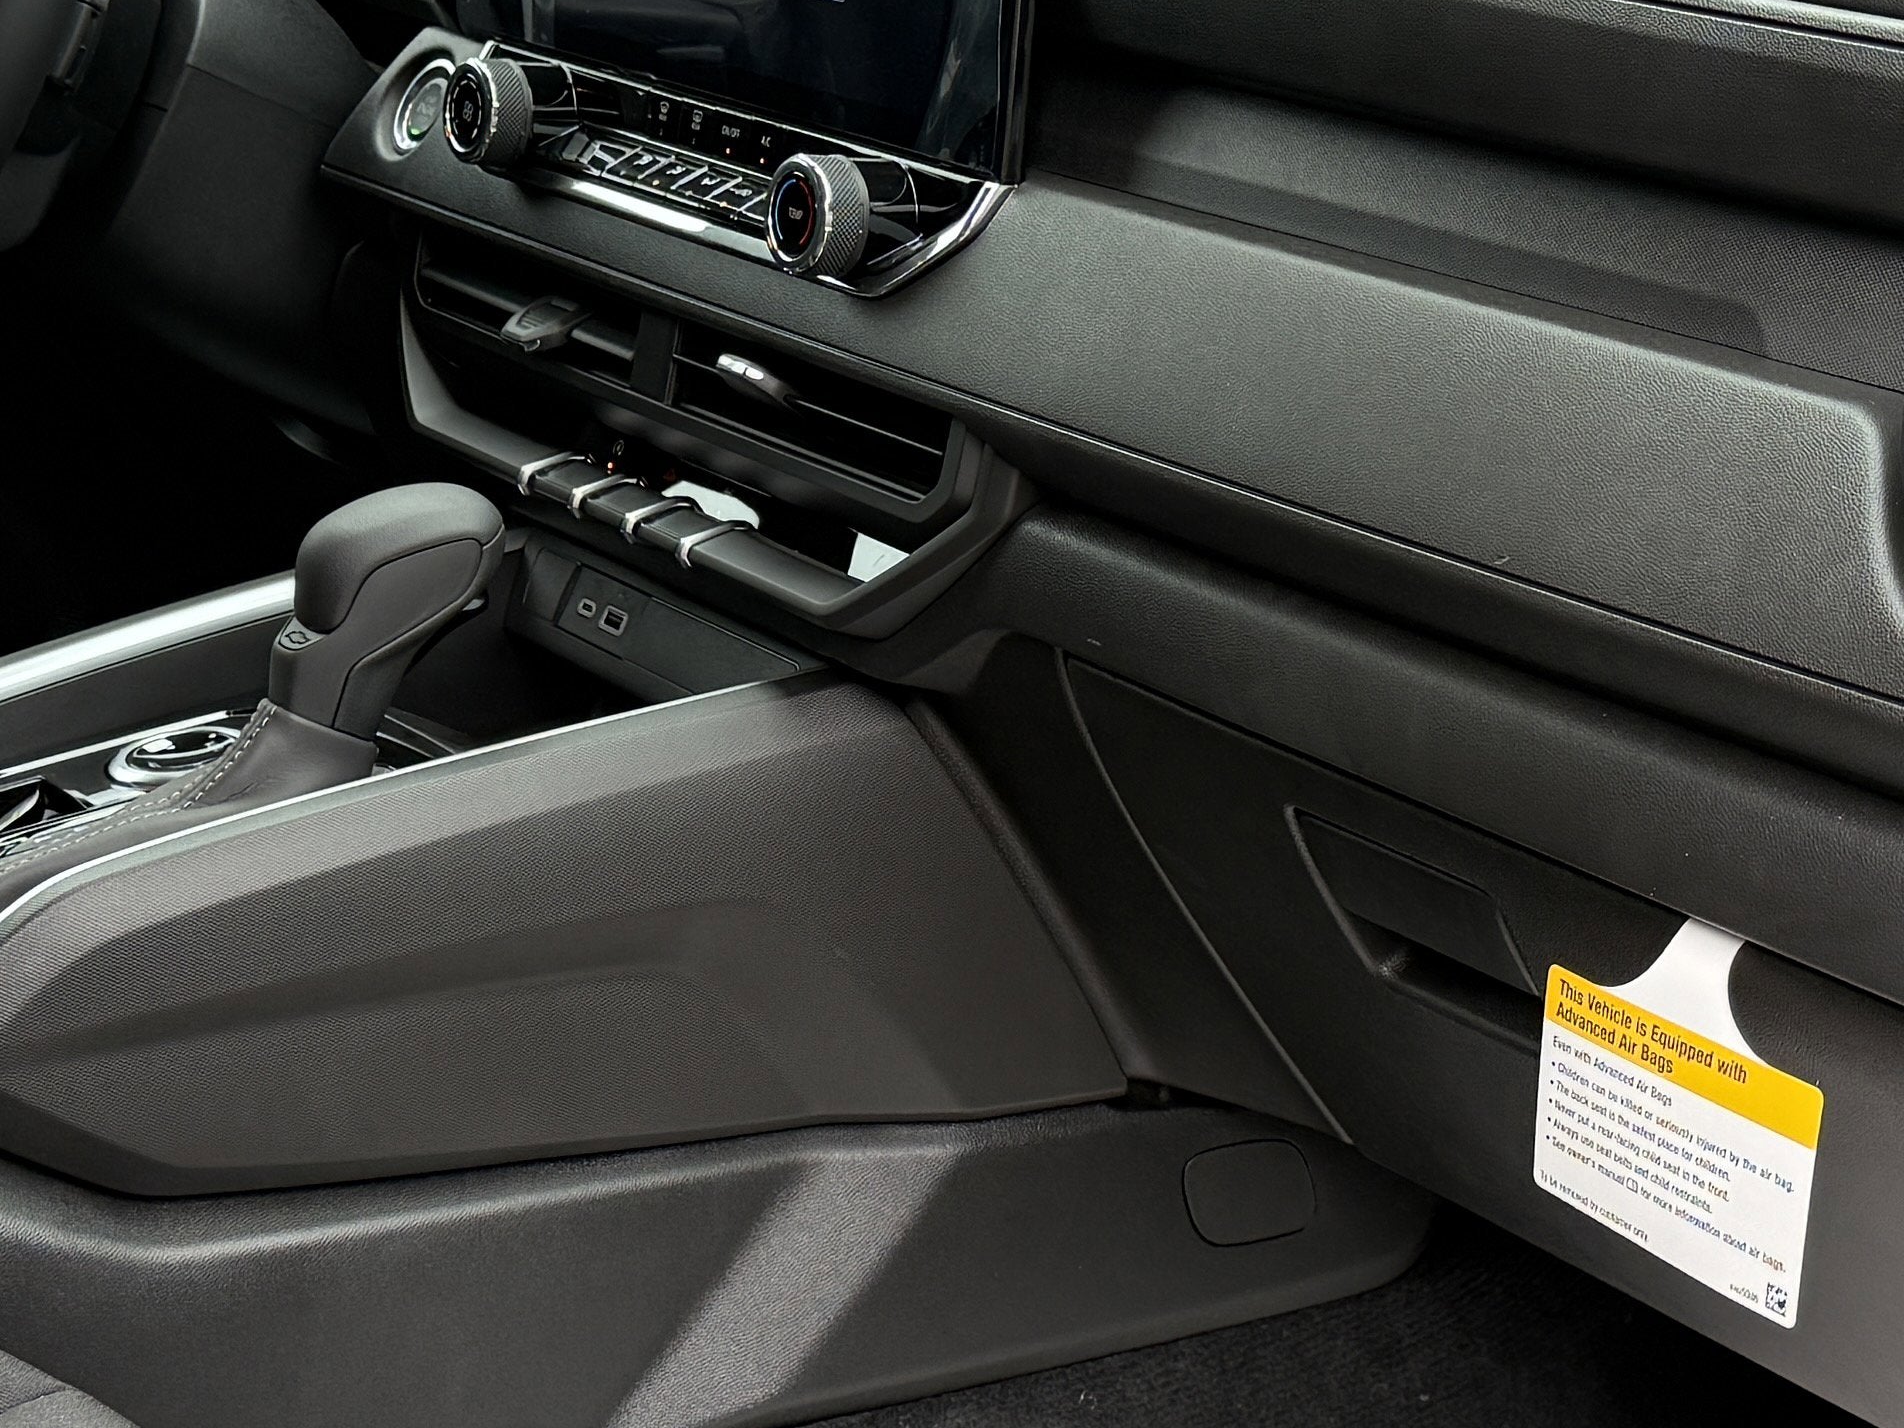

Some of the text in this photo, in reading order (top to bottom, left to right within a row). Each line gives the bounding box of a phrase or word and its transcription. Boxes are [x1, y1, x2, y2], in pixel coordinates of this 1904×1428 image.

[1556, 1002, 1673, 1074] Advanced Air Bags
[1560, 978, 1747, 1084] This Vehicle is Equipped with
[1552, 1035, 1572, 1054] Even
[1651, 1085, 1672, 1107] Bags
[1556, 1079, 1570, 1096] The
[1591, 1082, 1606, 1096] can
